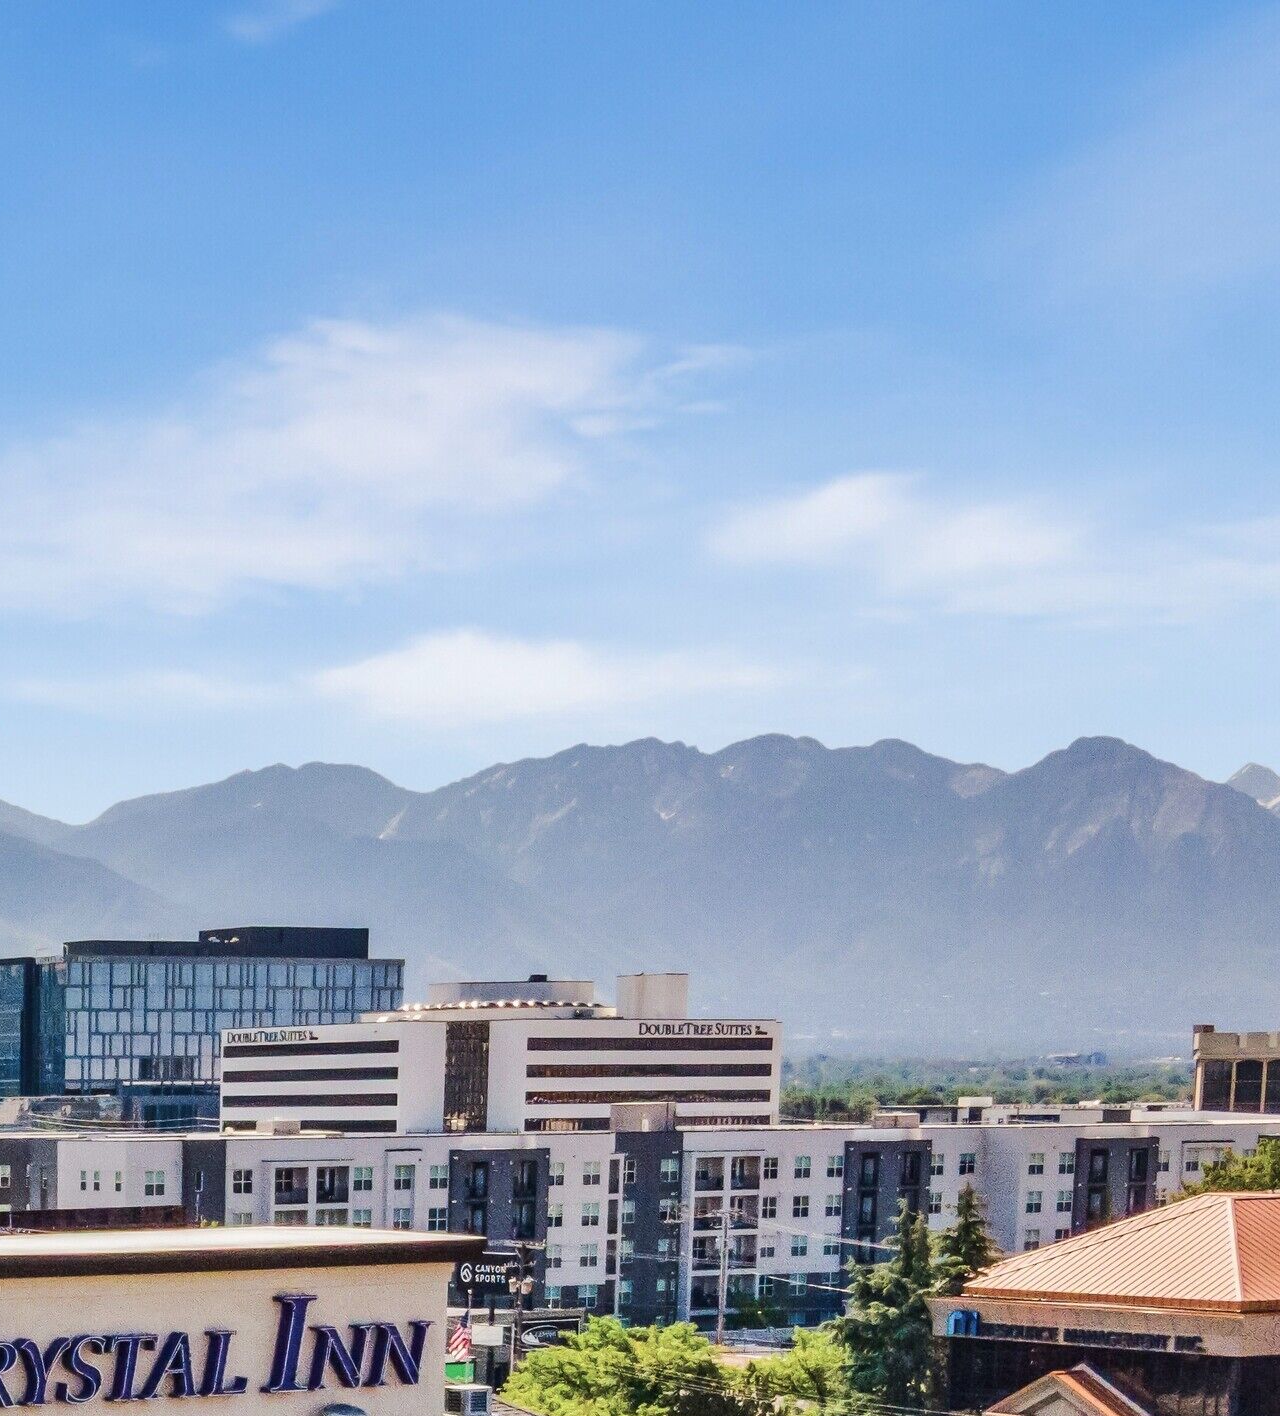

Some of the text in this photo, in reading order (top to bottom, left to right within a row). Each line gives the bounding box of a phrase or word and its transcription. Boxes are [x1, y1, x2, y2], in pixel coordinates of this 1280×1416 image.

[714, 1022, 752, 1035] SUITES
[474, 1264, 507, 1274] CANYON
[474, 1274, 506, 1284] SPORTS
[259, 1294, 436, 1394] INN
